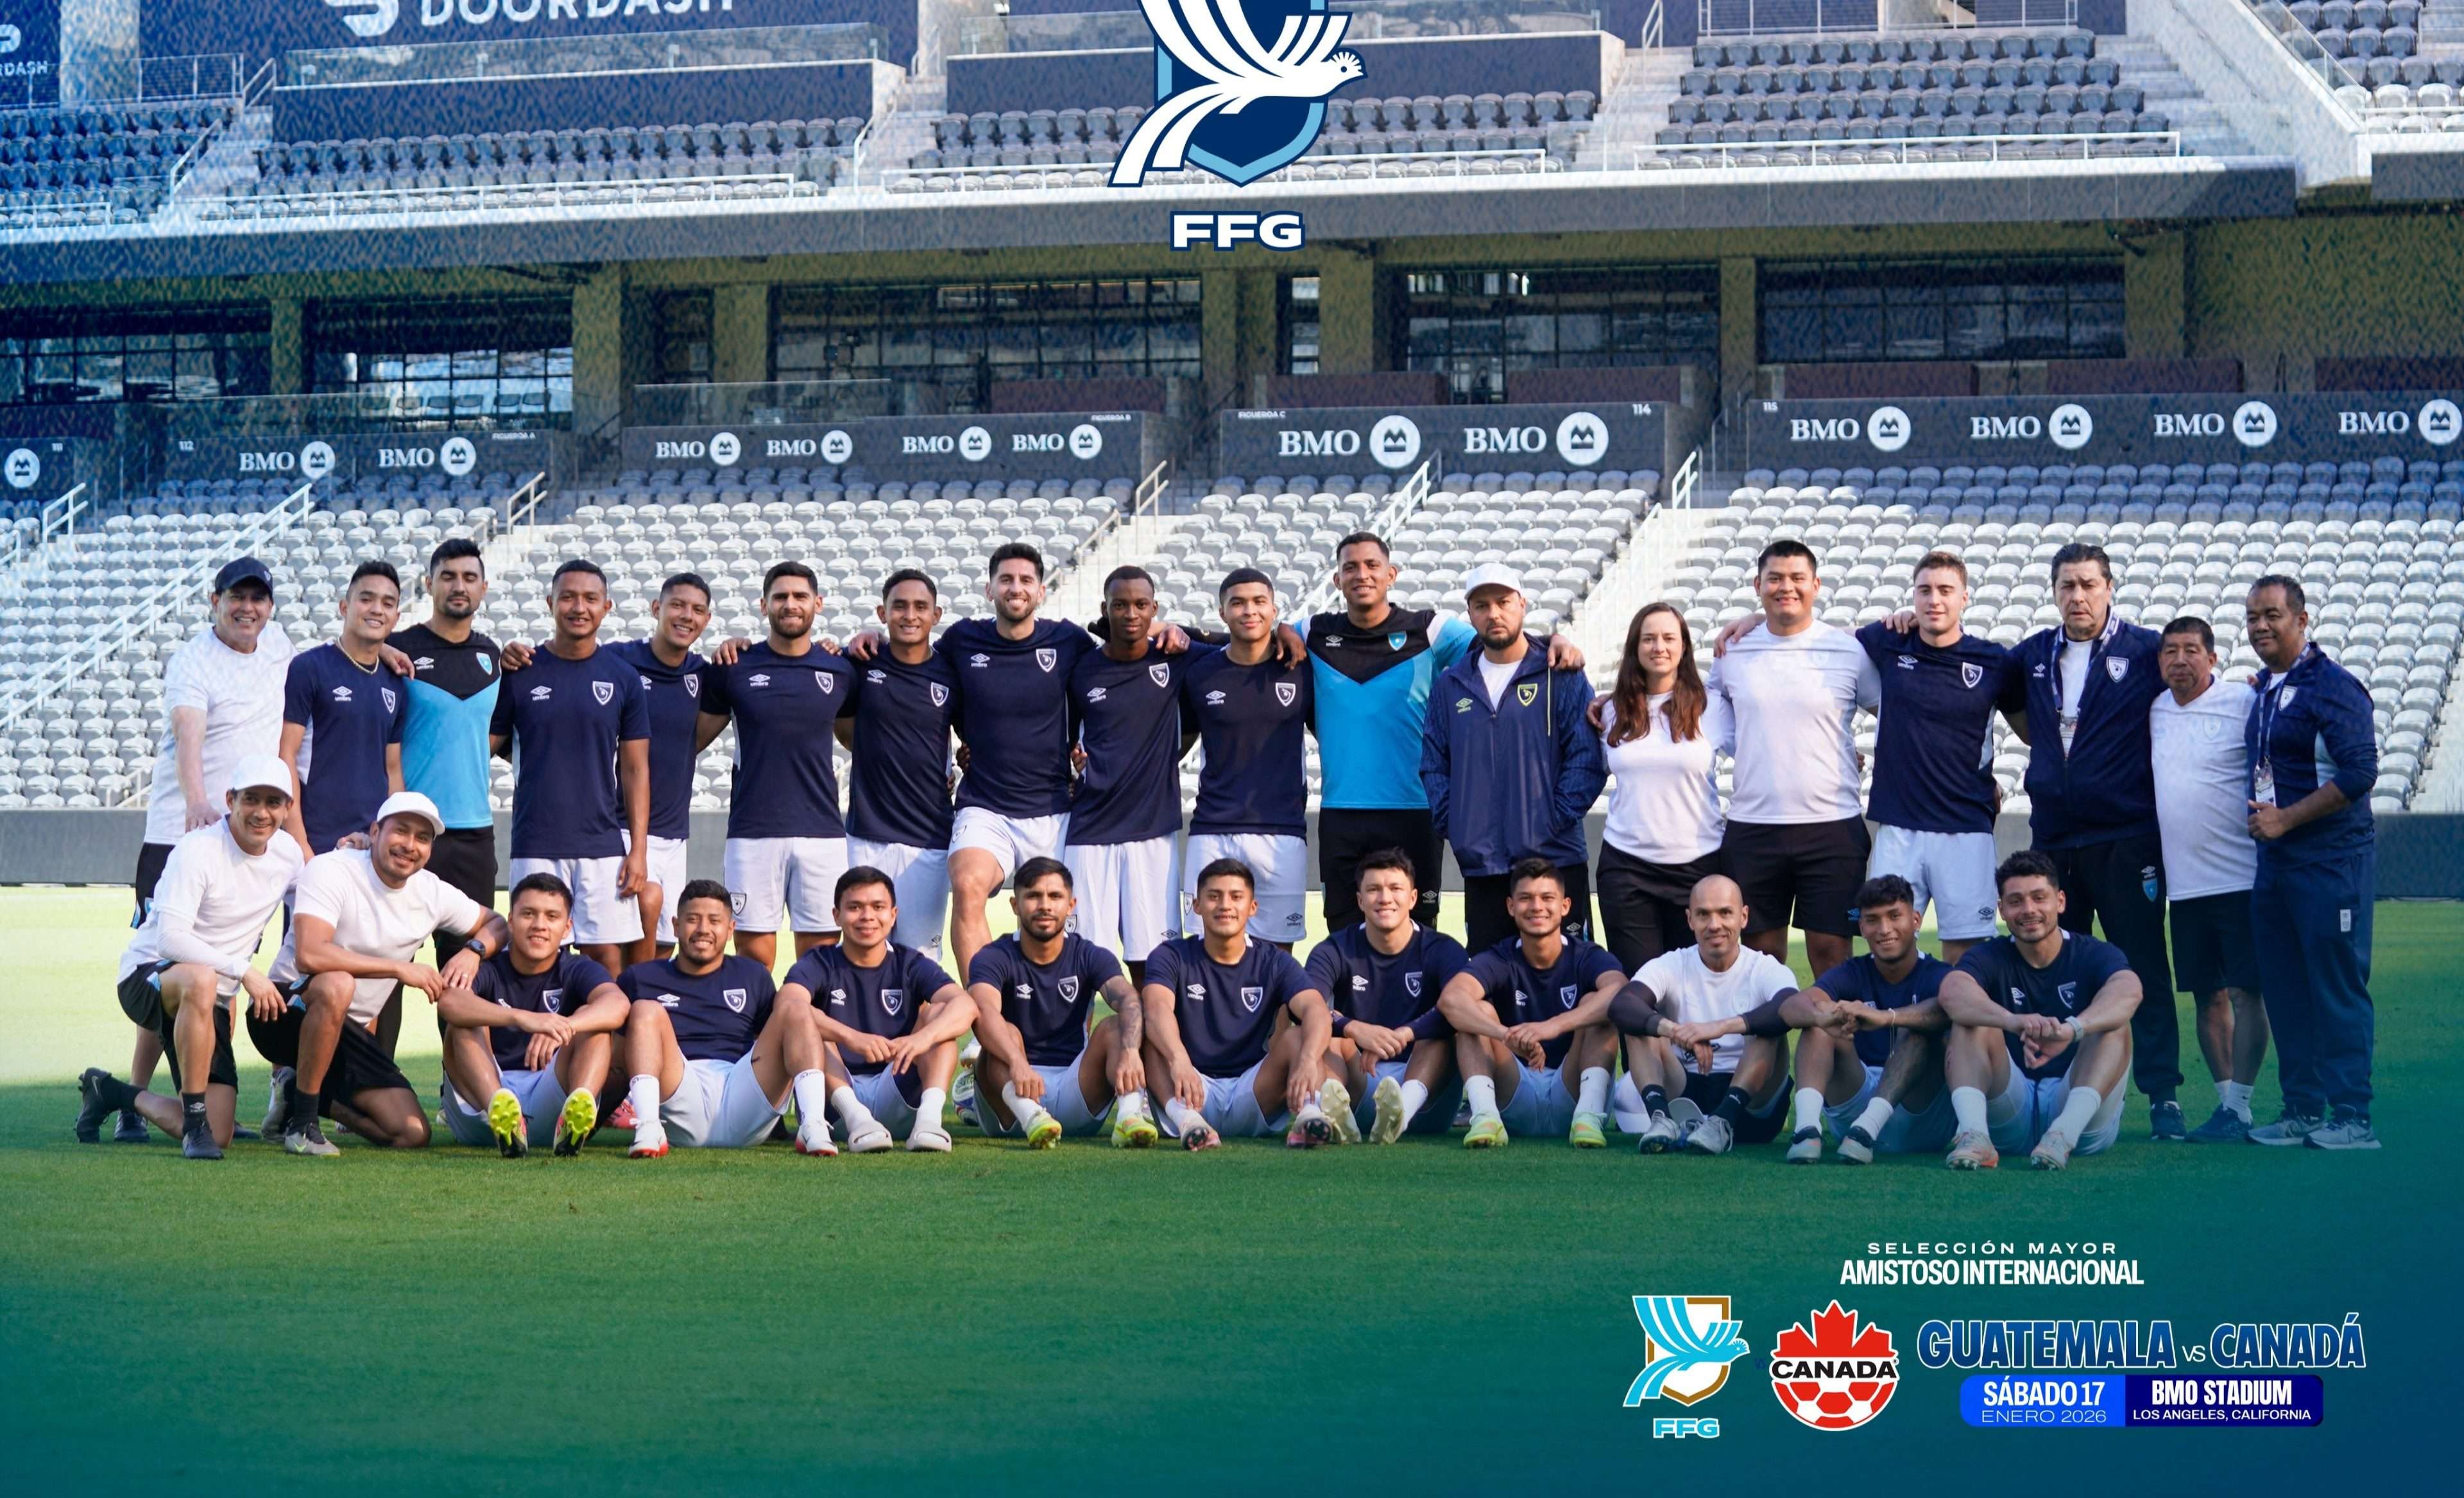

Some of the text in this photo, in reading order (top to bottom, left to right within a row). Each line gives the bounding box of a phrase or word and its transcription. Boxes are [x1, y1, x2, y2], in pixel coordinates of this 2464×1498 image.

[0, 60, 47, 76] DASH
[1632, 403, 1652, 415] 114
[1763, 401, 1778, 413] 115
[1790, 418, 1860, 442] BMO
[1971, 416, 2041, 439] BMO
[2153, 413, 2225, 436] BMO
[2338, 411, 2410, 435] BMO
[179, 440, 194, 451] 112
[767, 439, 817, 456] BMO
[903, 435, 955, 453] BMO
[1012, 433, 1065, 451] BMO
[1278, 429, 1360, 456] BMO
[1464, 426, 1547, 454] BMO
[379, 448, 435, 467] BMO
[655, 441, 705, 459] BMO
[239, 451, 295, 471] BMO
